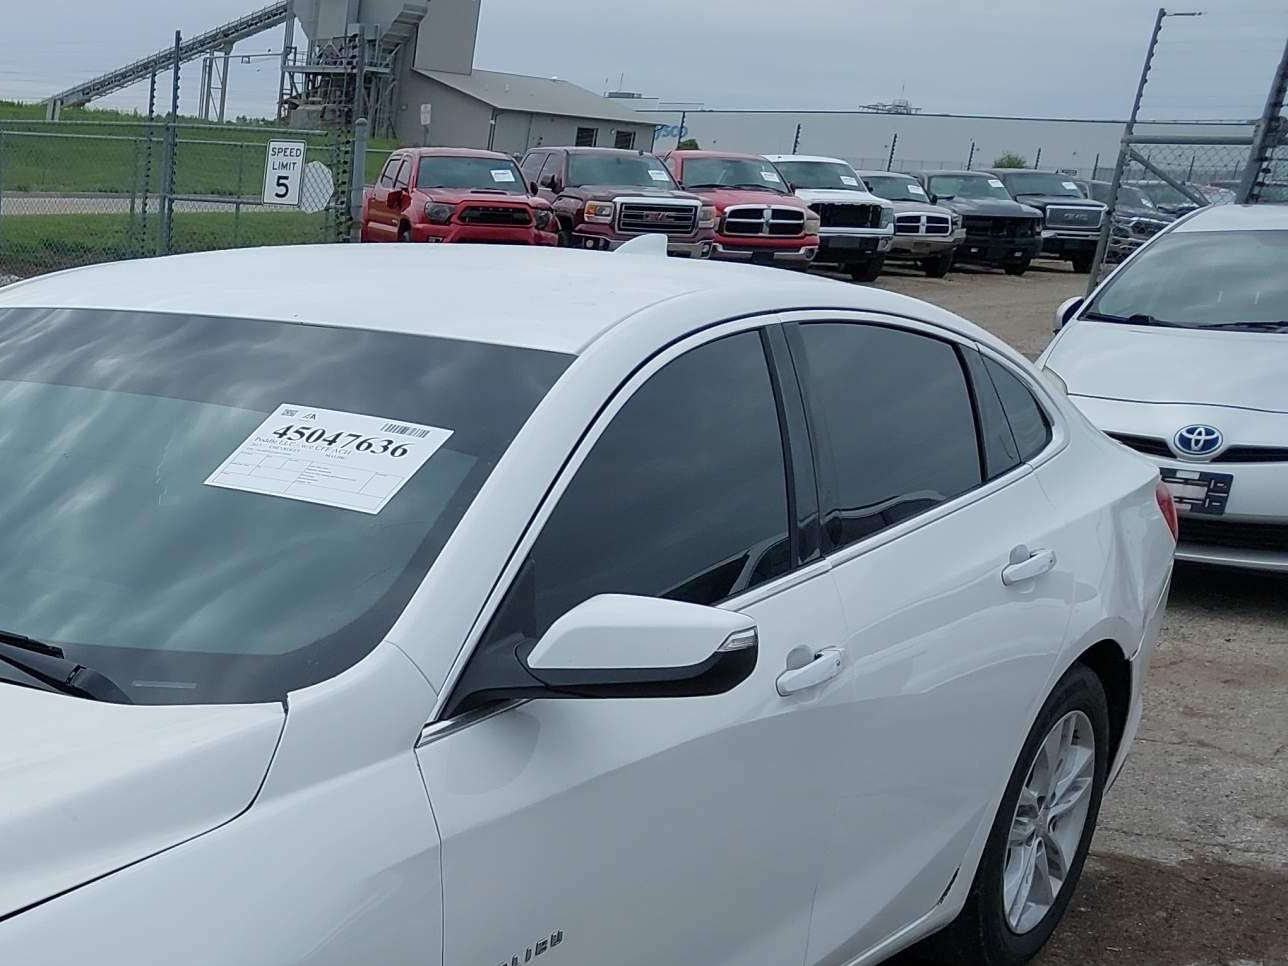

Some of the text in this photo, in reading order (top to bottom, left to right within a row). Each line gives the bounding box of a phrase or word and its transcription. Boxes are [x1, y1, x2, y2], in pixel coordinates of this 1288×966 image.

[271, 146, 302, 158] SPEED
[272, 161, 297, 171] LIMIT
[274, 175, 290, 198] 5
[272, 424, 416, 458] 45047636
